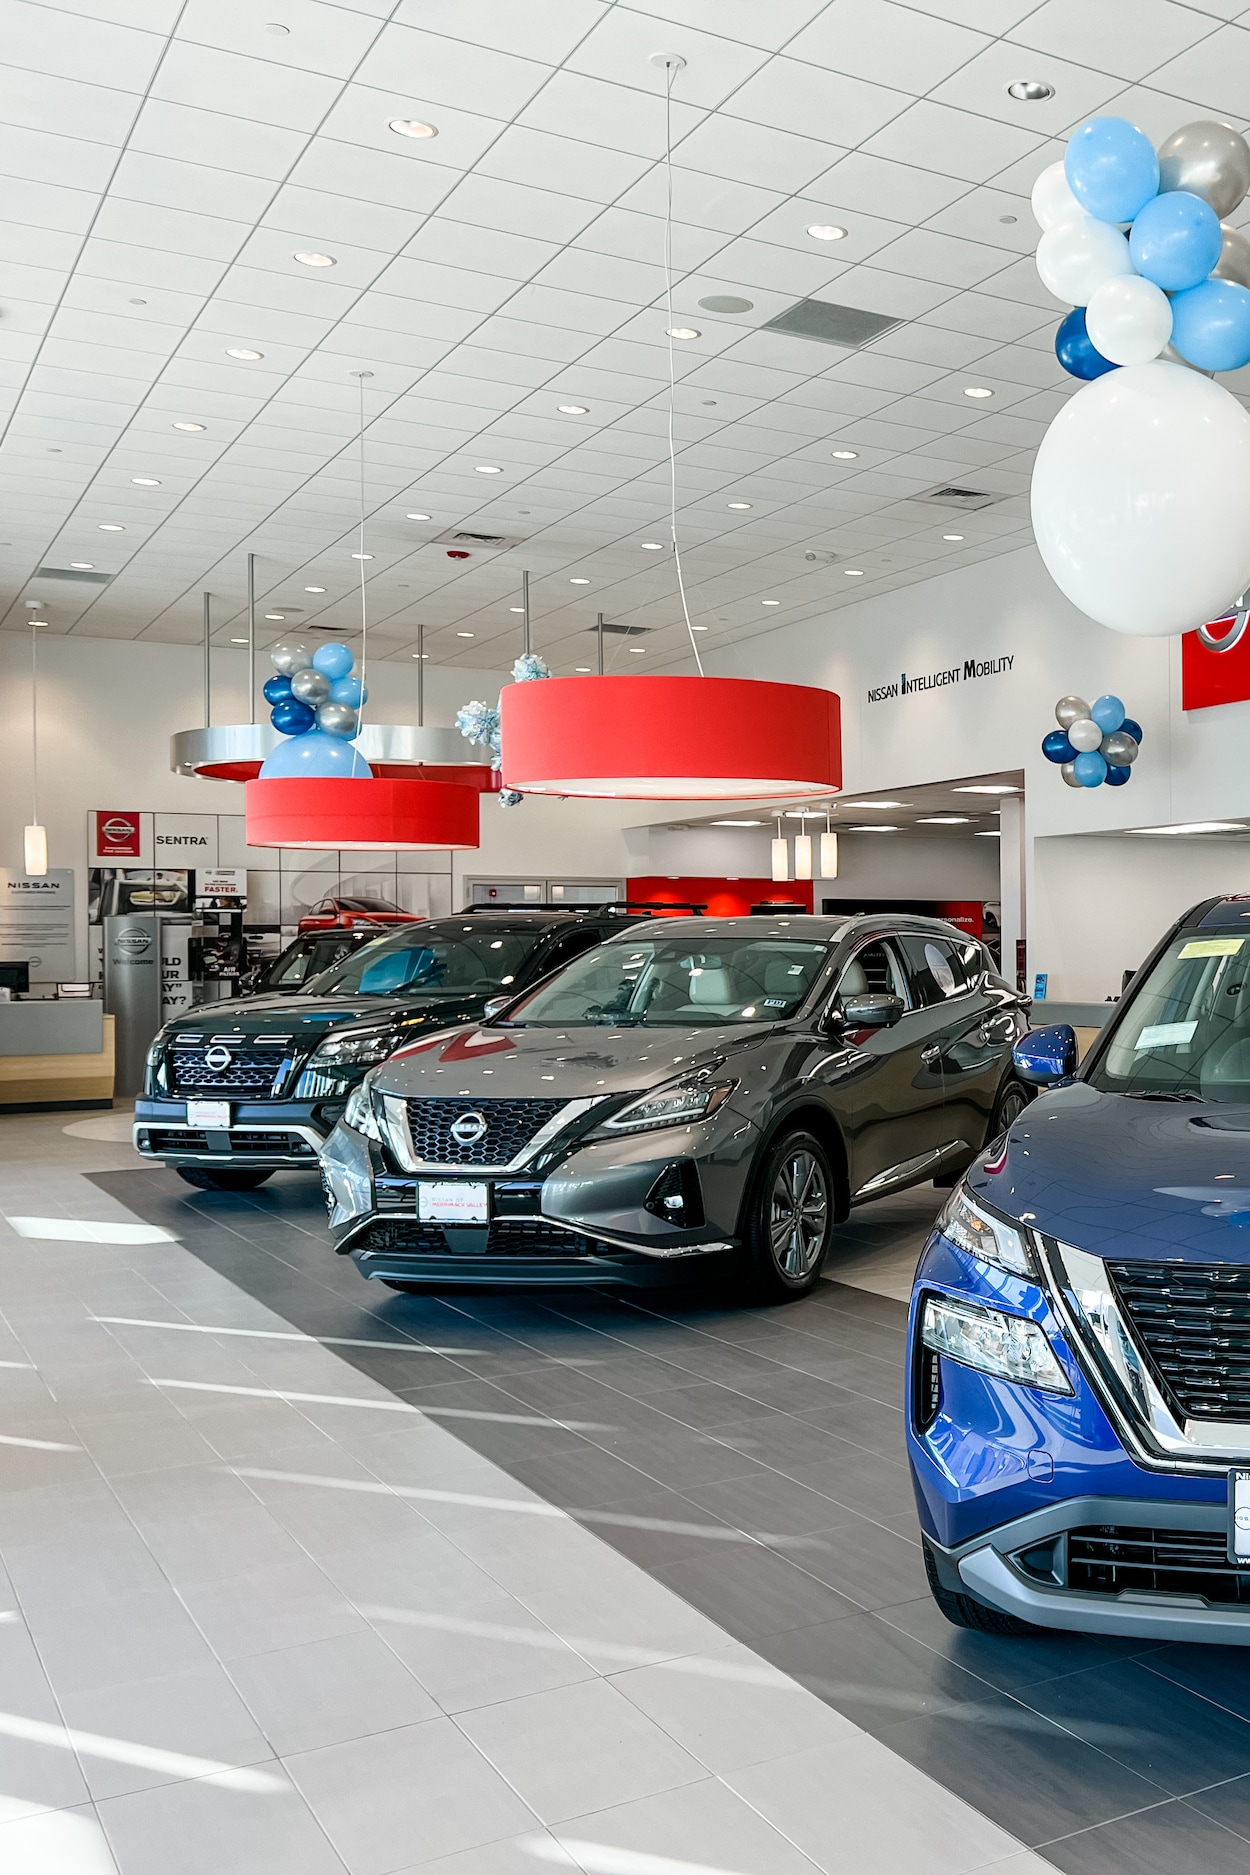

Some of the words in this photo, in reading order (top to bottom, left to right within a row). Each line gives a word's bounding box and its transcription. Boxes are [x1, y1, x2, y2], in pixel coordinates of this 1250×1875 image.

[867, 683, 899, 704] NISSAN
[155, 835, 208, 846] SENTRA
[112, 958, 154, 966] Welcome
